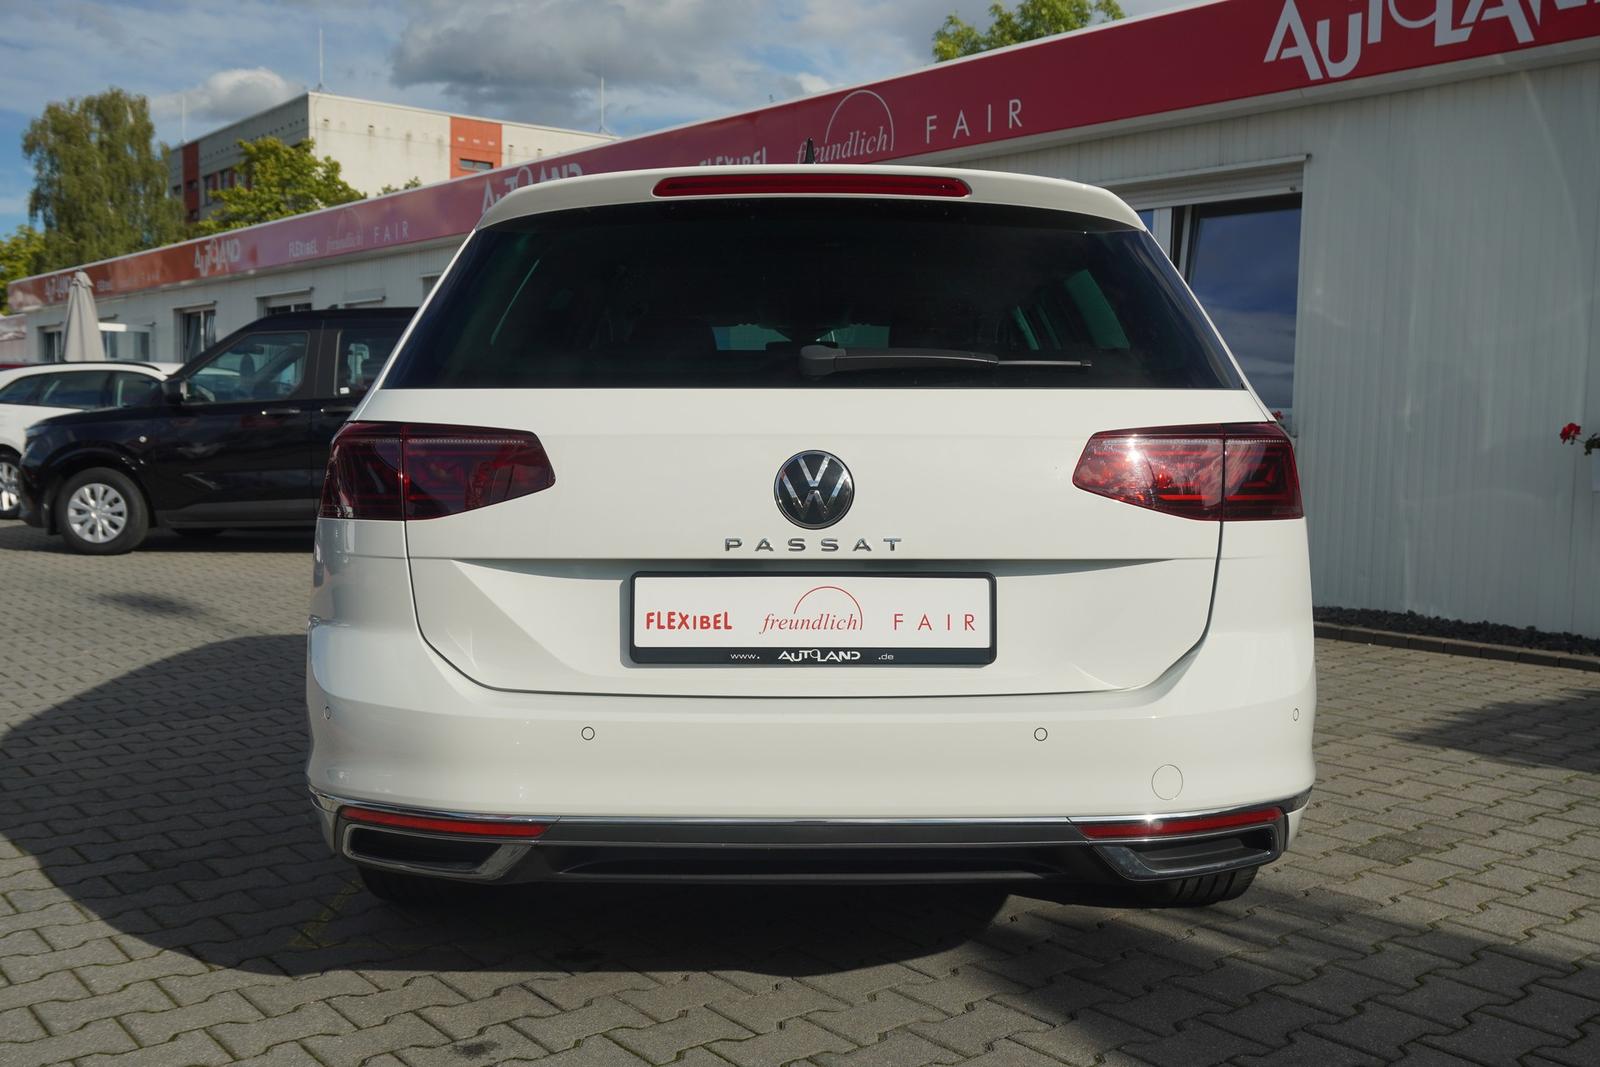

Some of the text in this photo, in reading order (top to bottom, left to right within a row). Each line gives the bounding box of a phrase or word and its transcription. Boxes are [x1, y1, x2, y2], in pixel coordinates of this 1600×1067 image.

[926, 98, 1023, 145] FAIR
[373, 220, 409, 244] FAIR
[725, 538, 903, 552] PASSAT
[645, 611, 976, 636] FLEXIBEL freundlich FAIR
[730, 648, 895, 663] www. AUTOLAND .de
